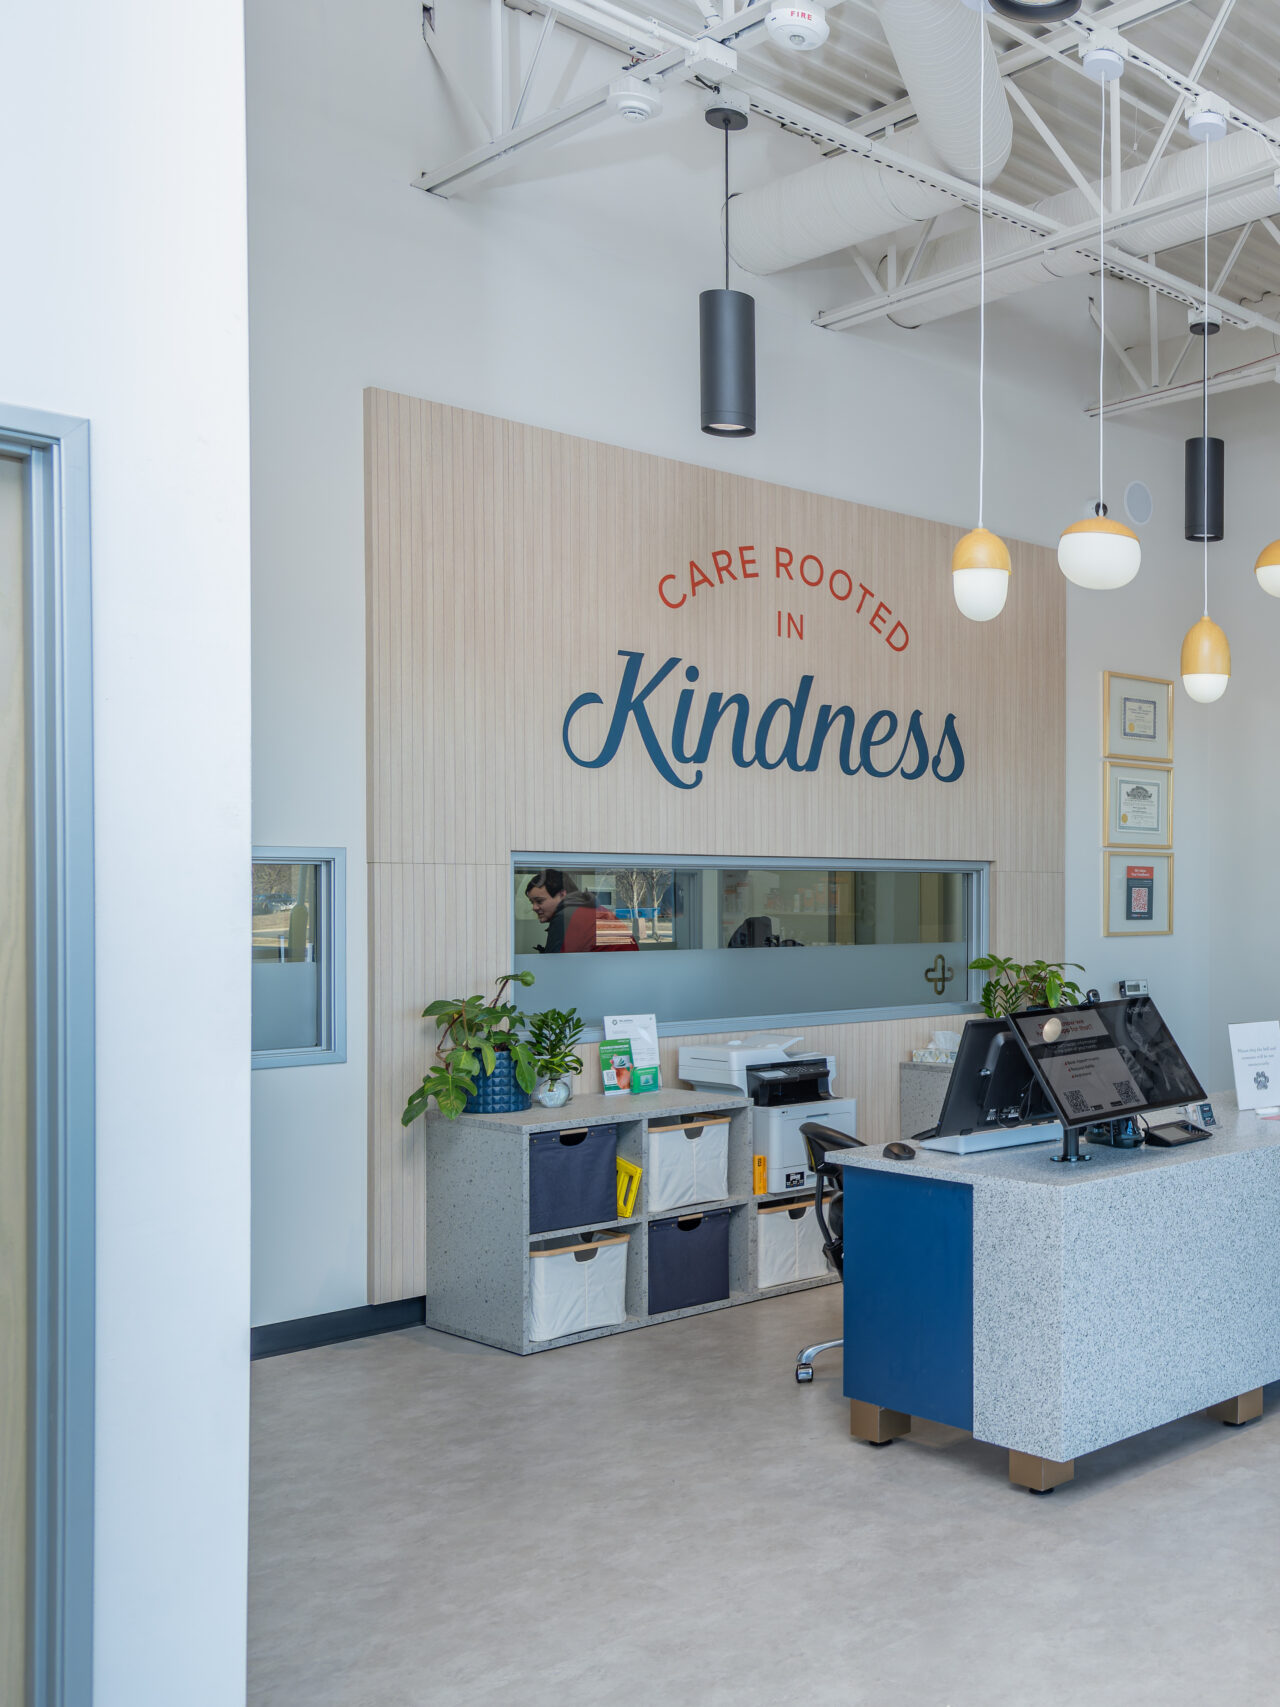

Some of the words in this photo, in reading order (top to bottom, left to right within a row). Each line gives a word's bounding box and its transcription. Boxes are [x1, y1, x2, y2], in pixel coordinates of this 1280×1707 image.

[790, 10, 813, 21] FIRE
[658, 545, 760, 609] CARE
[774, 546, 911, 653] ROOTED
[777, 610, 805, 641] IN
[562, 649, 966, 790] Kindness
